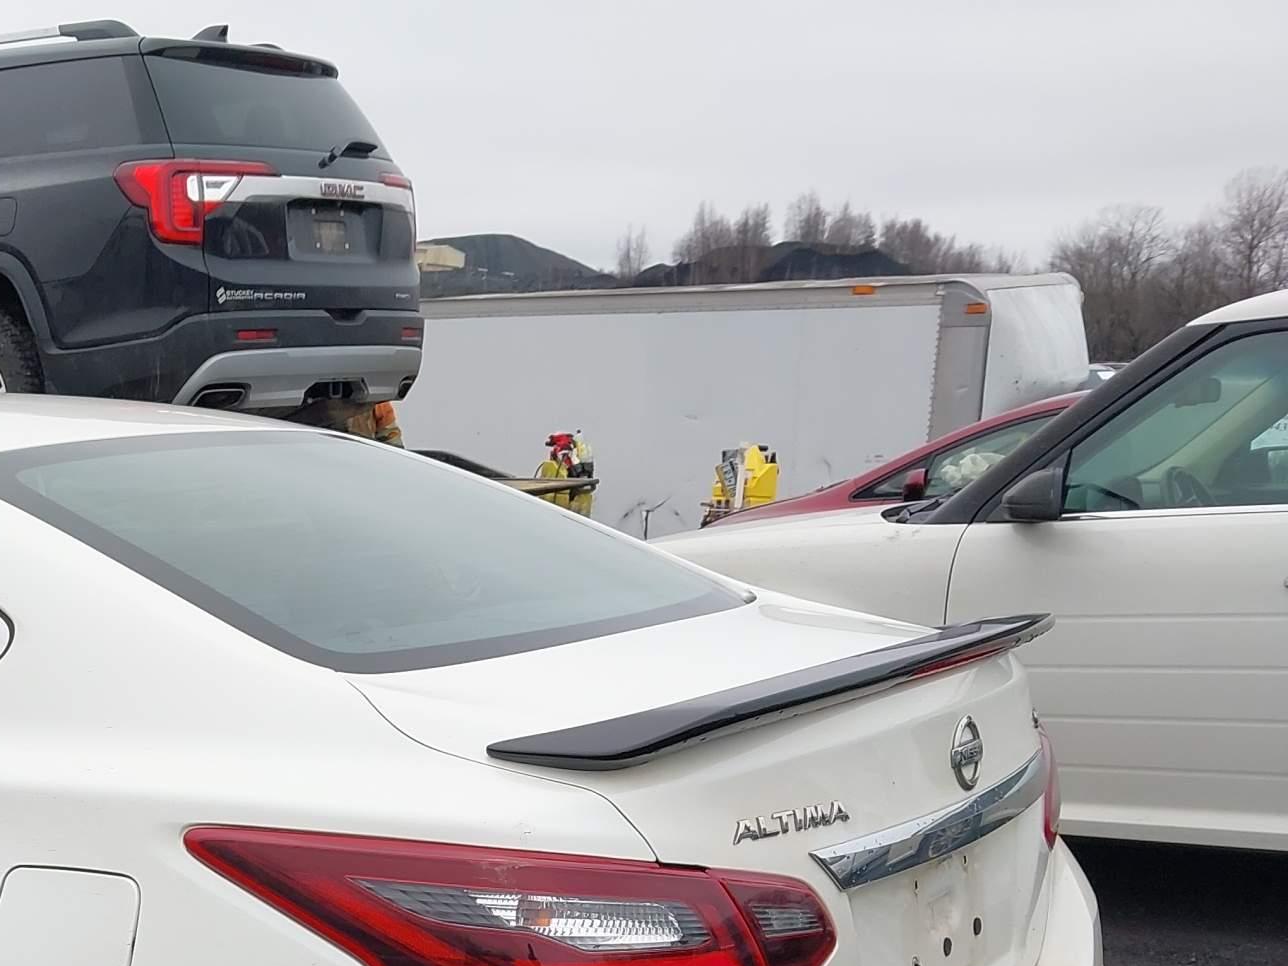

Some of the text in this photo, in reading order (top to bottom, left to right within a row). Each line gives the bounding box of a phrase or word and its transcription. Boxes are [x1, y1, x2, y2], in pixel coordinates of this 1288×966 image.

[320, 183, 365, 199] GMC
[254, 292, 306, 300] ACADIA
[732, 799, 850, 846] ALTIMA
